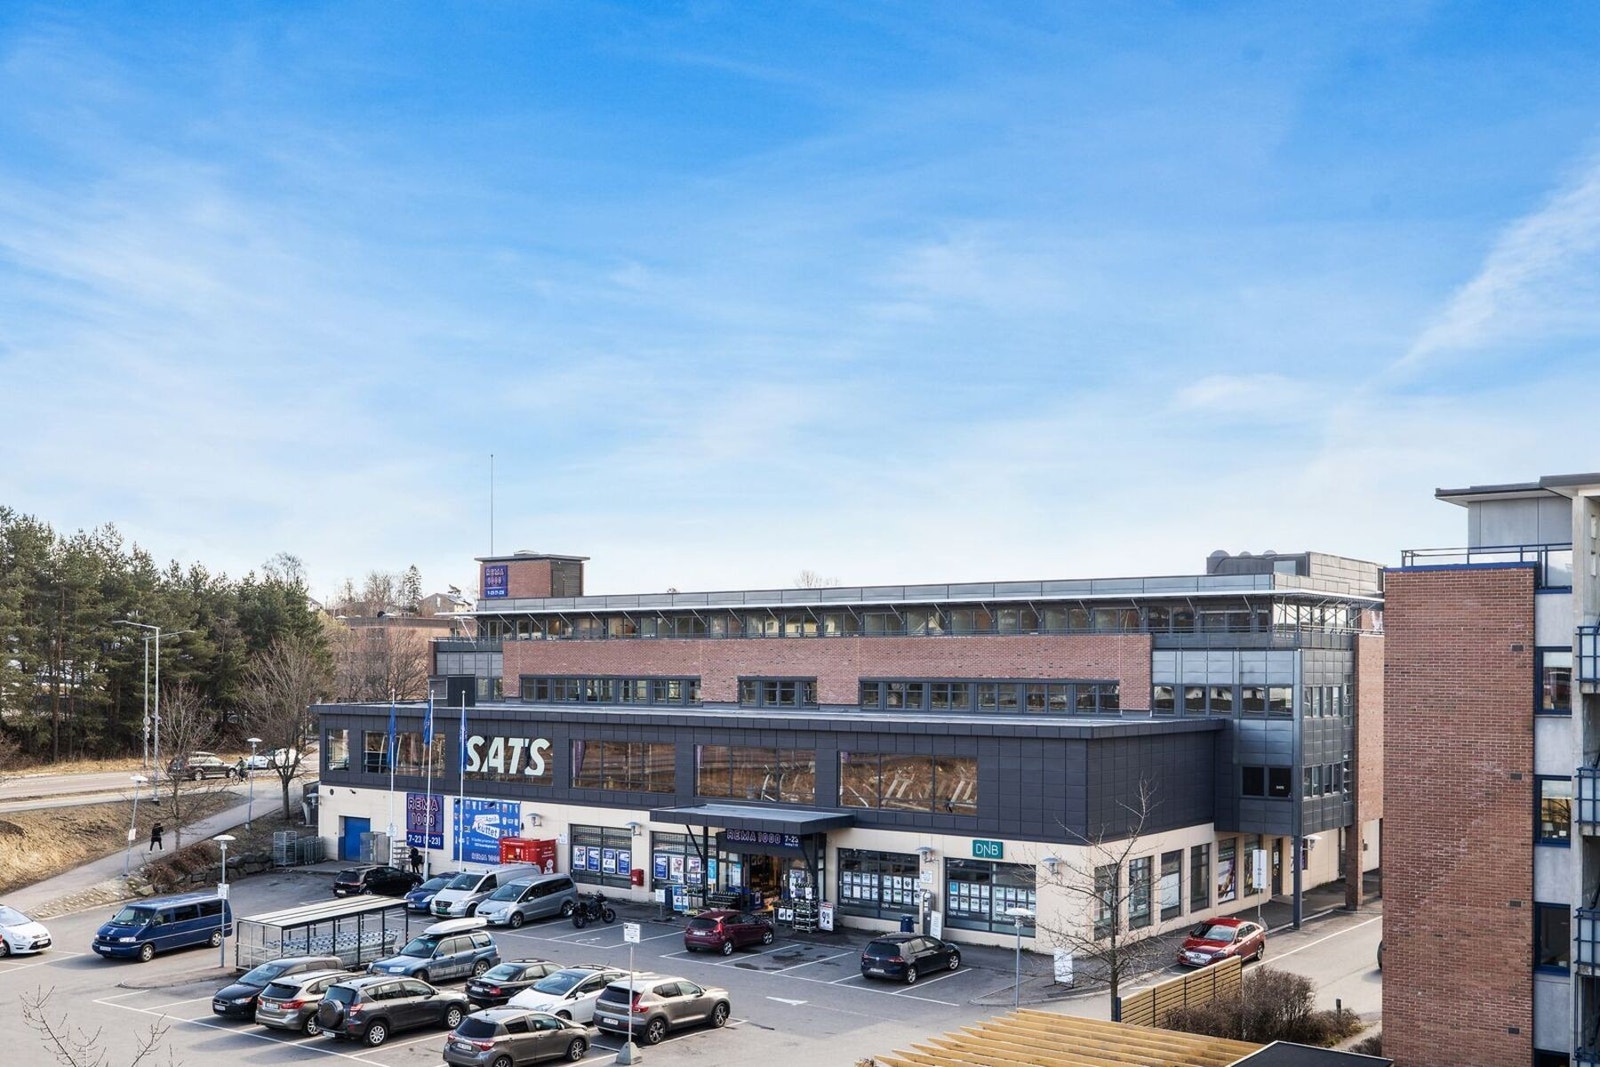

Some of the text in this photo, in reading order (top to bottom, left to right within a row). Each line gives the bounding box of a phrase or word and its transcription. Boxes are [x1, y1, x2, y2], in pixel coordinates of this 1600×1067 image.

[466, 735, 551, 776] SATS
[408, 797, 439, 812] REMA
[411, 812, 435, 827] 1000
[408, 834, 441, 846] 7-23 (-23)
[726, 829, 756, 842] REMA
[757, 832, 781, 844] 1000
[975, 840, 999, 858] DNB
